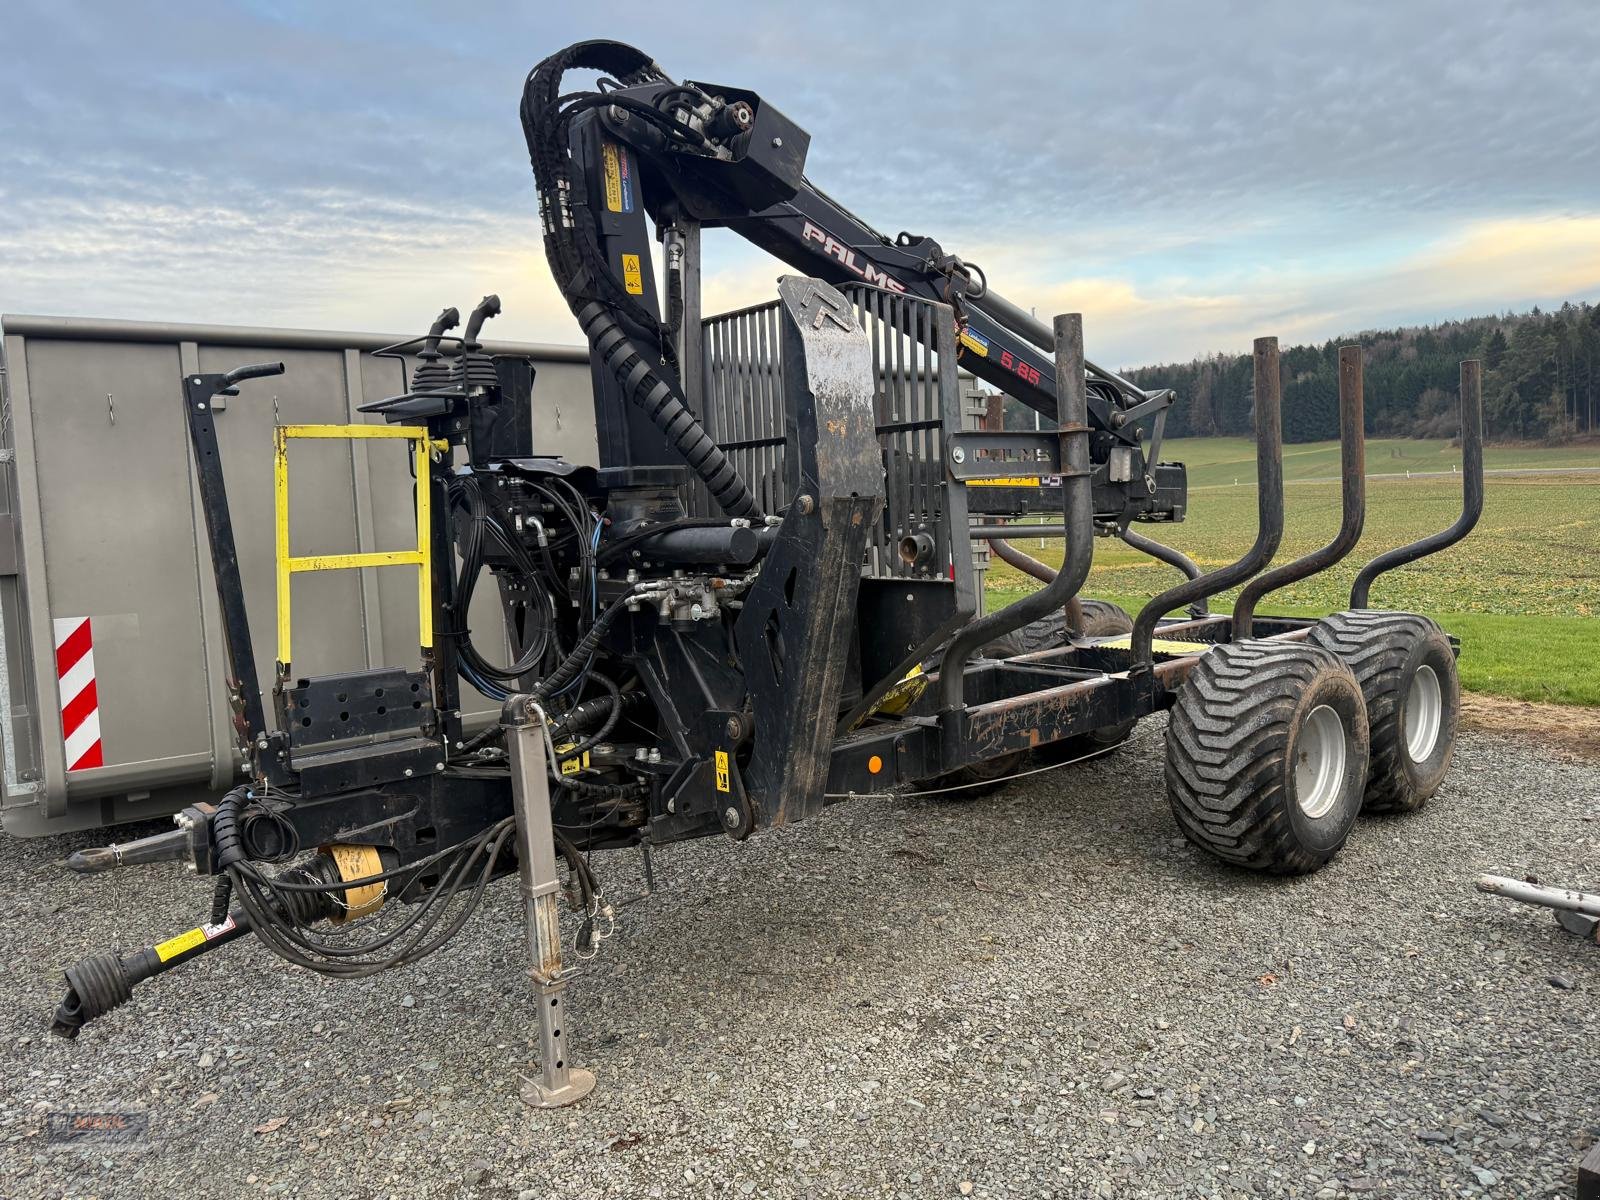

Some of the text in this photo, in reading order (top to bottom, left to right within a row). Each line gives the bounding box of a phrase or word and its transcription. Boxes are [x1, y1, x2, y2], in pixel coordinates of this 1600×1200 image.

[802, 221, 906, 293] PALMS
[1001, 351, 1041, 385] 5.85
[973, 448, 1051, 463] PALMS
